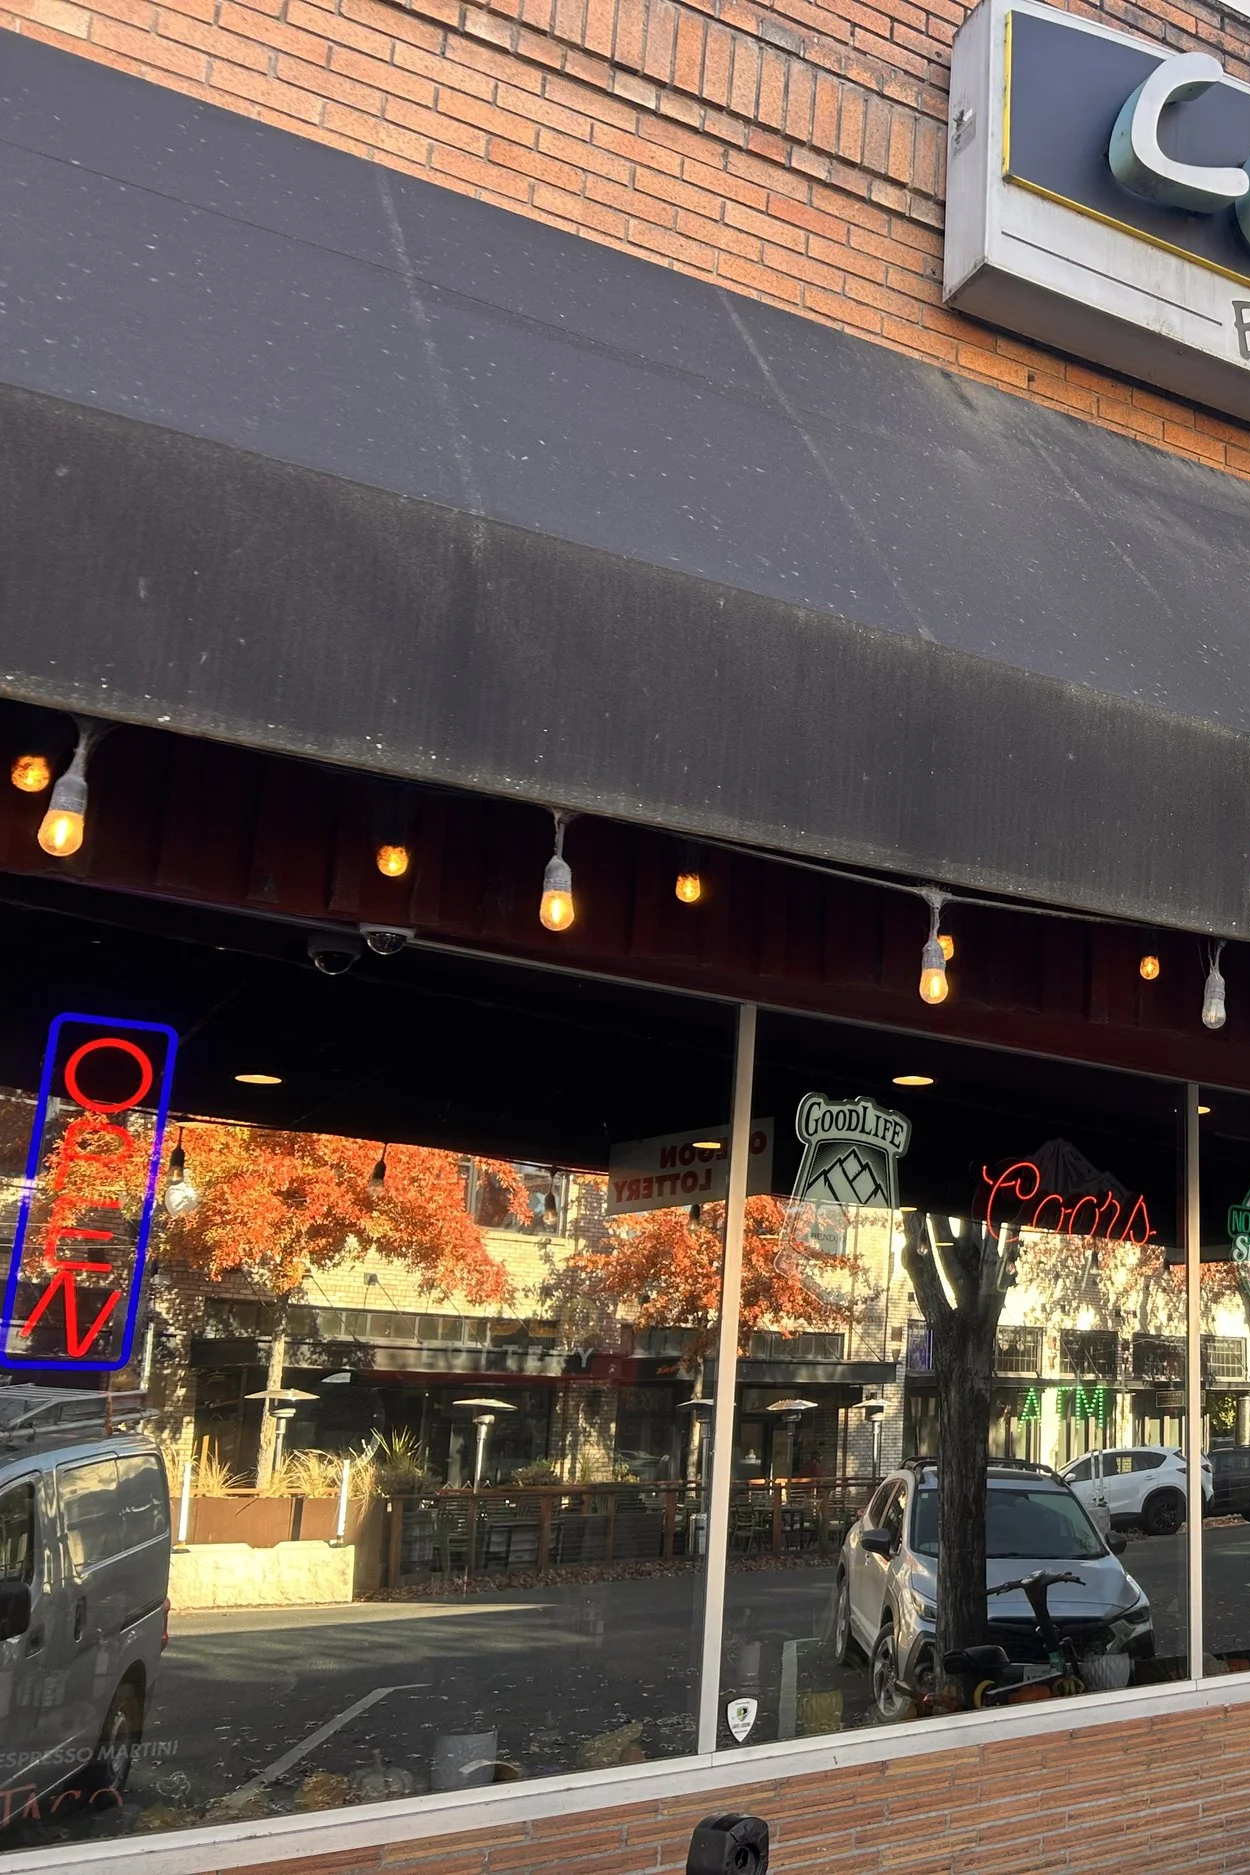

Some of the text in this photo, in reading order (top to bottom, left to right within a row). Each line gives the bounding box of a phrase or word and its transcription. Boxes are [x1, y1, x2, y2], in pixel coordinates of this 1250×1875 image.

[804, 1101, 904, 1150] GOODLIFE
[19, 1037, 153, 1358] OPEN
[981, 1161, 1157, 1246] Coors
[1016, 1384, 1105, 1433] ATM
[97, 1740, 179, 1761] MARTINI
